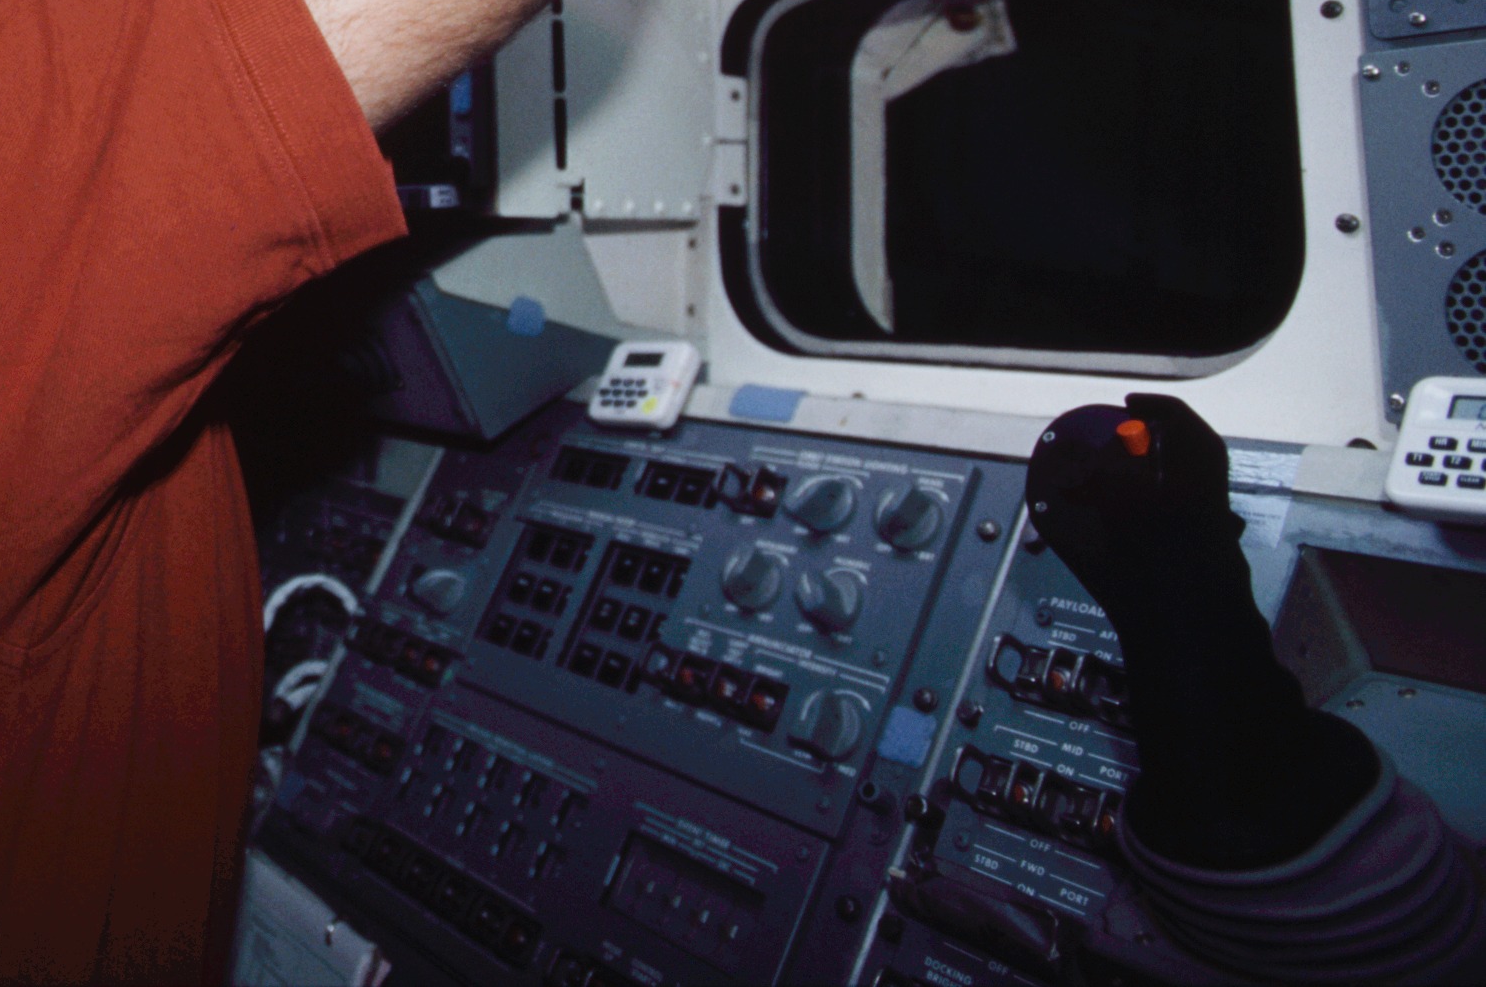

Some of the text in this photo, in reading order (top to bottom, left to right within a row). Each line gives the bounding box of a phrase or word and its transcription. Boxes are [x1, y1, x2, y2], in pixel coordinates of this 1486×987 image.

[1049, 596, 1106, 619] PAYLOAD
[1050, 628, 1077, 643] STBD
[1094, 648, 1113, 662] ON
[1068, 720, 1091, 734] OFF
[1013, 737, 1040, 755] STBD
[1060, 742, 1085, 757] MID
[1055, 763, 1076, 777] ON
[1028, 838, 1052, 853] OFF
[1019, 859, 1046, 876] FWD
[973, 853, 1090, 907] STBD PORT
[1016, 882, 1036, 897] ON
[923, 955, 973, 986] DOCKING
[987, 959, 1010, 976] OFF
